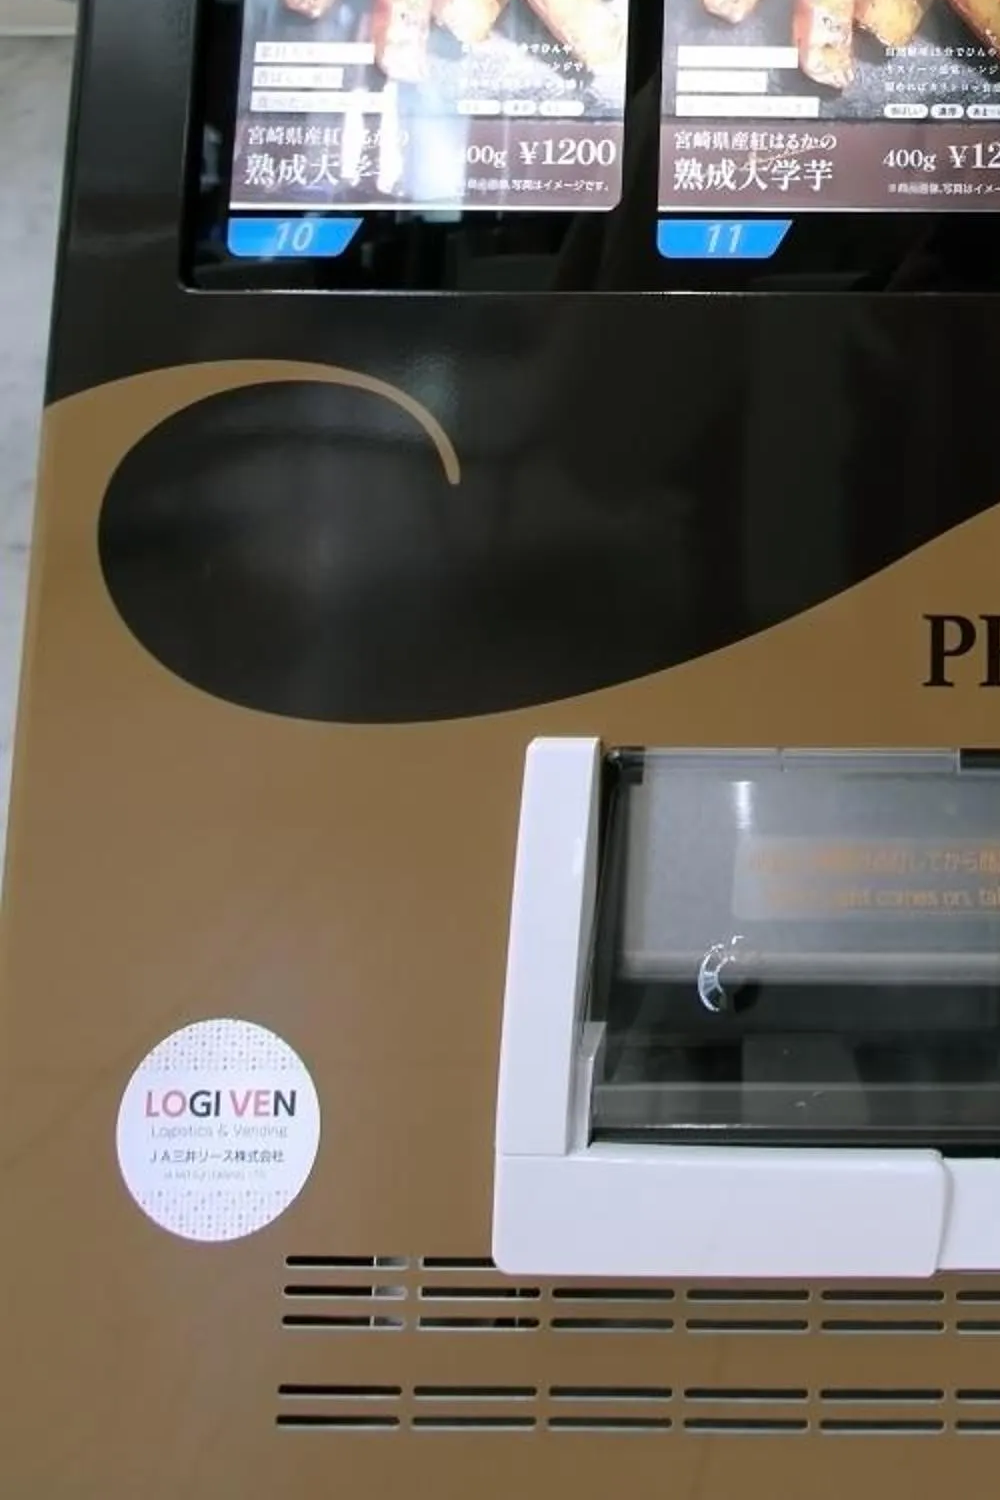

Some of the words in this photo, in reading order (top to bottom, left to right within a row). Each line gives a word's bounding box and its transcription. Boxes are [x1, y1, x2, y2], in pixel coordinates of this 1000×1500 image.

[459, 144, 508, 170] 00g
[519, 138, 617, 166] ¥1200
[673, 130, 838, 151] 宮崎県産紅はるかの
[673, 156, 835, 192] 熟成大学芋
[882, 148, 937, 173] 400g
[276, 222, 314, 251] 10
[706, 223, 744, 254] 11
